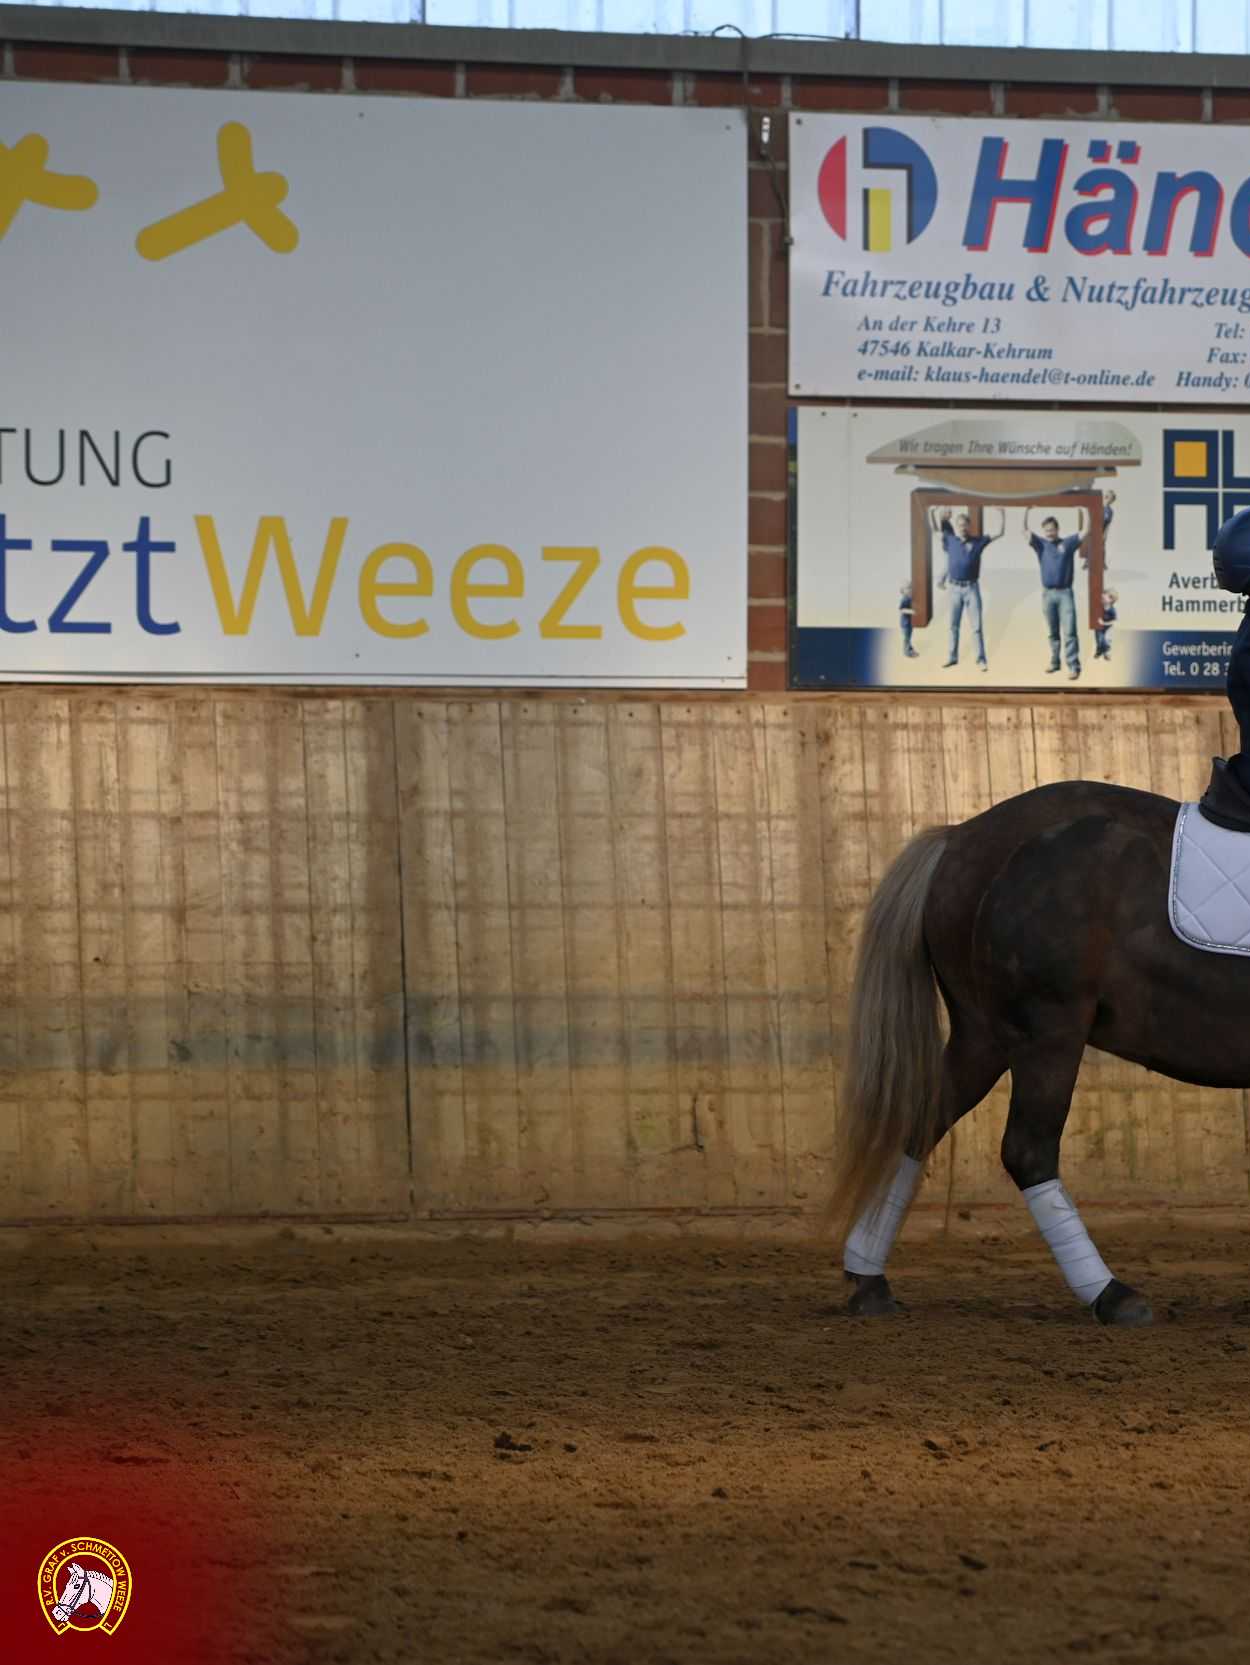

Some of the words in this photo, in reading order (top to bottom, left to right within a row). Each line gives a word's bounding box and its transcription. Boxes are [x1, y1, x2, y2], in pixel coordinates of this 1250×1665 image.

[822, 270, 1015, 307] Fahrzeugbau
[1025, 274, 1050, 302] &
[857, 315, 883, 333] An
[888, 316, 918, 333] der
[923, 316, 975, 334] Kehre
[981, 317, 1002, 334] 13
[1214, 322, 1245, 340] Tel:
[857, 340, 911, 357] 47546
[915, 340, 1053, 360] Kalkar-Kehrum
[1206, 347, 1248, 365] Fax:
[857, 365, 919, 383] e-mail:
[924, 366, 1155, 387] klaus-haendel@t-online.de
[1176, 371, 1239, 392] Handy:
[900, 440, 920, 454] Wir
[968, 440, 994, 455] Ihre
[998, 440, 1050, 456] Wünsche
[1162, 661, 1185, 676] Tel.
[1190, 662, 1199, 676] 0
[1203, 662, 1220, 676] 28
